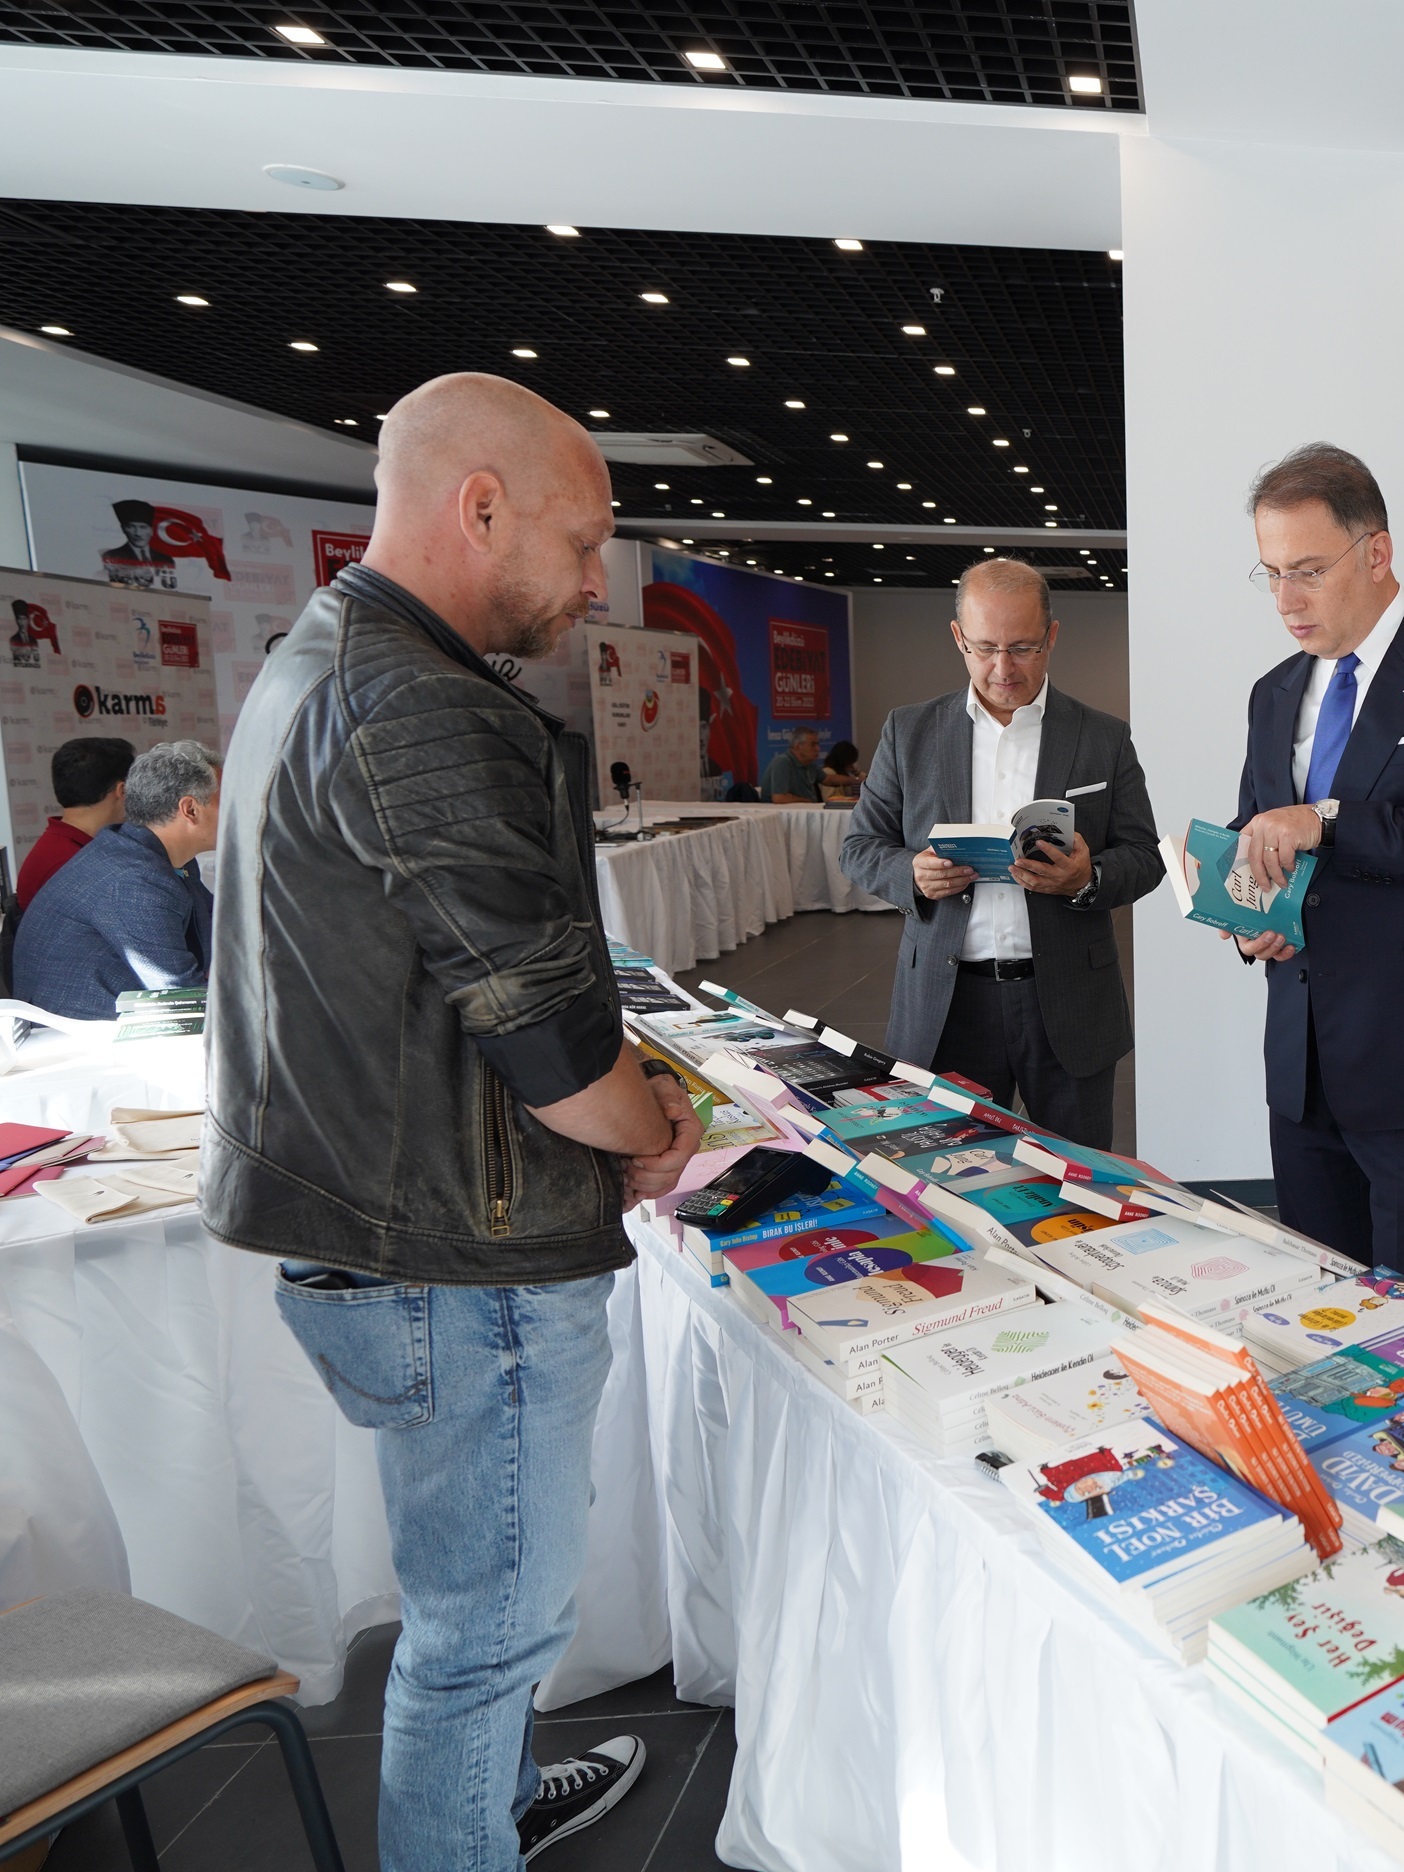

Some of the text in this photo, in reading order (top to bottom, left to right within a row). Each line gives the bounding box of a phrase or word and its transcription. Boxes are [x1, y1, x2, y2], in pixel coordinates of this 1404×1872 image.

[775, 673, 815, 693] GÜNLERİ
[1231, 870, 1243, 902] Carl
[1246, 873, 1259, 909] Jung
[1284, 859, 1302, 899] Gary Bobroff
[1193, 913, 1206, 922] Gary
[1206, 917, 1228, 927] Bobroff
[719, 1218, 818, 1248] Gary John Bishop BIRAK BU İŞLERİ!
[986, 1226, 1002, 1243] Alan
[1078, 1241, 1124, 1271] Schopenhauer
[857, 1284, 906, 1315] Sigmund
[886, 1282, 922, 1303] Freud
[1079, 1294, 1095, 1306] Céline
[1157, 1278, 1187, 1296] Spinoza
[1234, 1292, 1253, 1305] Spinoza
[849, 1298, 1004, 1356] Alan Porter Sigmund Freud
[858, 1356, 879, 1370] Alan
[940, 1347, 985, 1377] Heidegger
[855, 1379, 877, 1392] Alan
[969, 1389, 990, 1401] Céline
[1031, 1364, 1060, 1382] Heidegger
[1067, 1357, 1086, 1371] Kendin
[1086, 1354, 1094, 1365] Ol
[871, 1397, 885, 1408] Ala
[1320, 1457, 1404, 1506] DAVİD
[1093, 1485, 1219, 1544] ŞARKISI
[1103, 1500, 1243, 1564] BİR NOEL
[1284, 1612, 1352, 1669] Her Şey
[1311, 1600, 1378, 1655] Değişir
